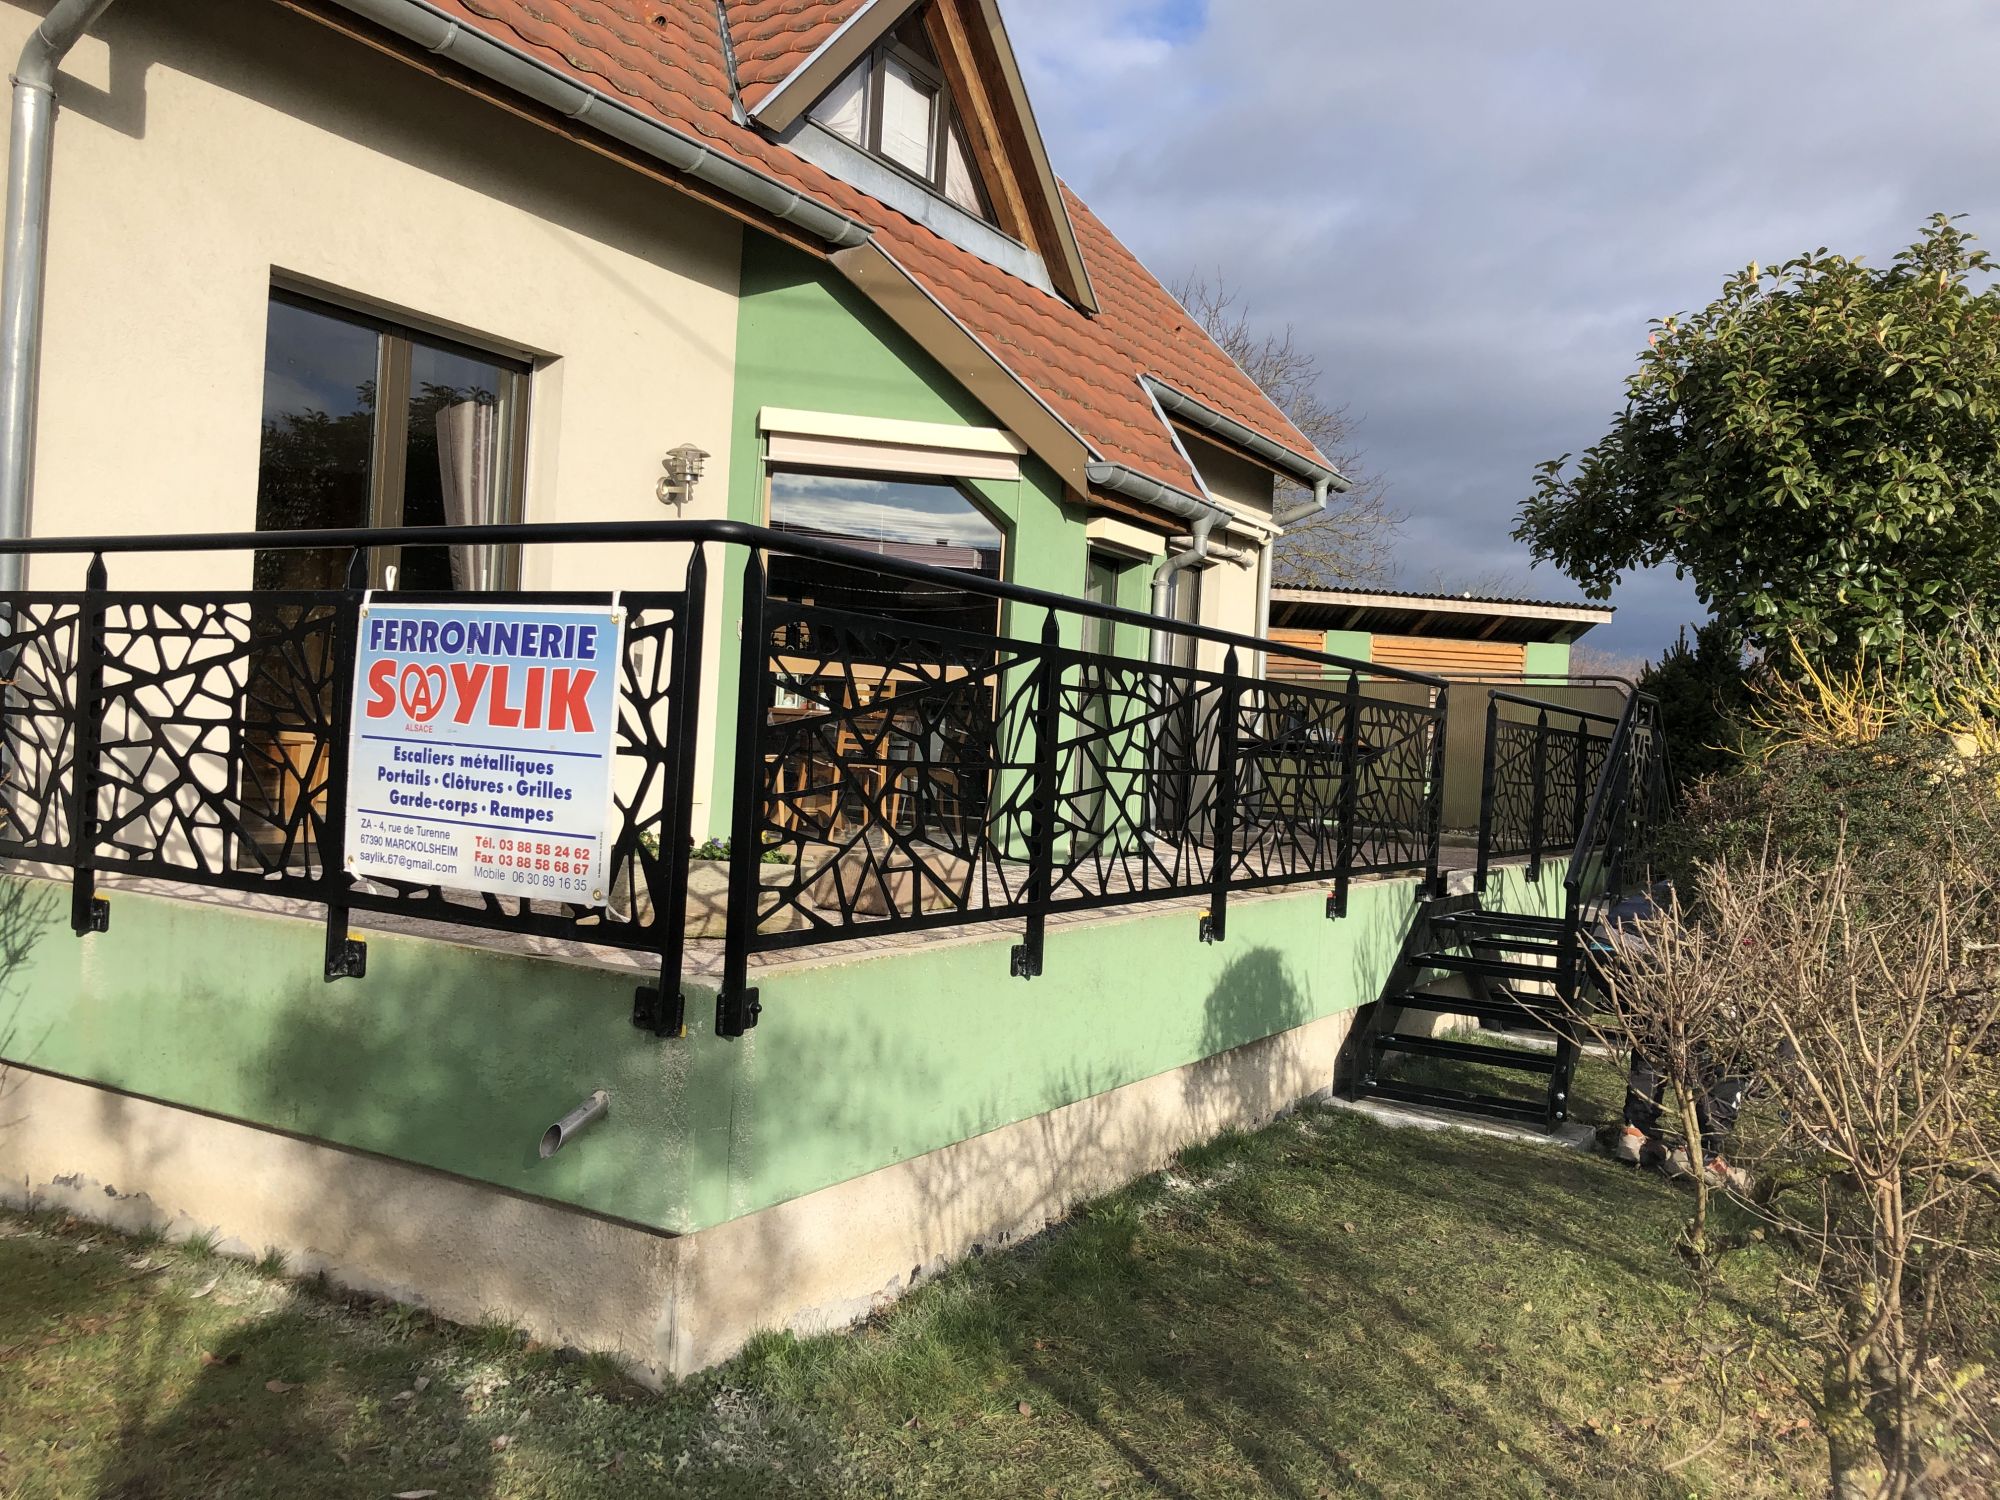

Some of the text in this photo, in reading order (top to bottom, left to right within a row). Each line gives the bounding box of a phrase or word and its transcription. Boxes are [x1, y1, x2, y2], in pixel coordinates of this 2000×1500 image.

[369, 618, 598, 661] FERRONNERIE
[405, 723, 433, 734] ALSACE
[394, 746, 554, 777] Escaliers métalliques
[378, 766, 573, 800] Portails Clôtures Grilles
[389, 789, 554, 824] Garde-corps Rampes
[361, 818, 372, 829] ZA
[388, 824, 402, 833] rue
[404, 824, 414, 835] de
[416, 825, 450, 840] Turenne
[360, 834, 458, 857] 67390 MARCKOLSHEIM
[475, 836, 590, 860] Tél. 03 88 58 24 62
[360, 851, 458, 874] saylik.67@gmail.com
[475, 851, 589, 875] Fax 03 88 58 68 67
[474, 866, 587, 891] Mobile 06 30 89 16 35
